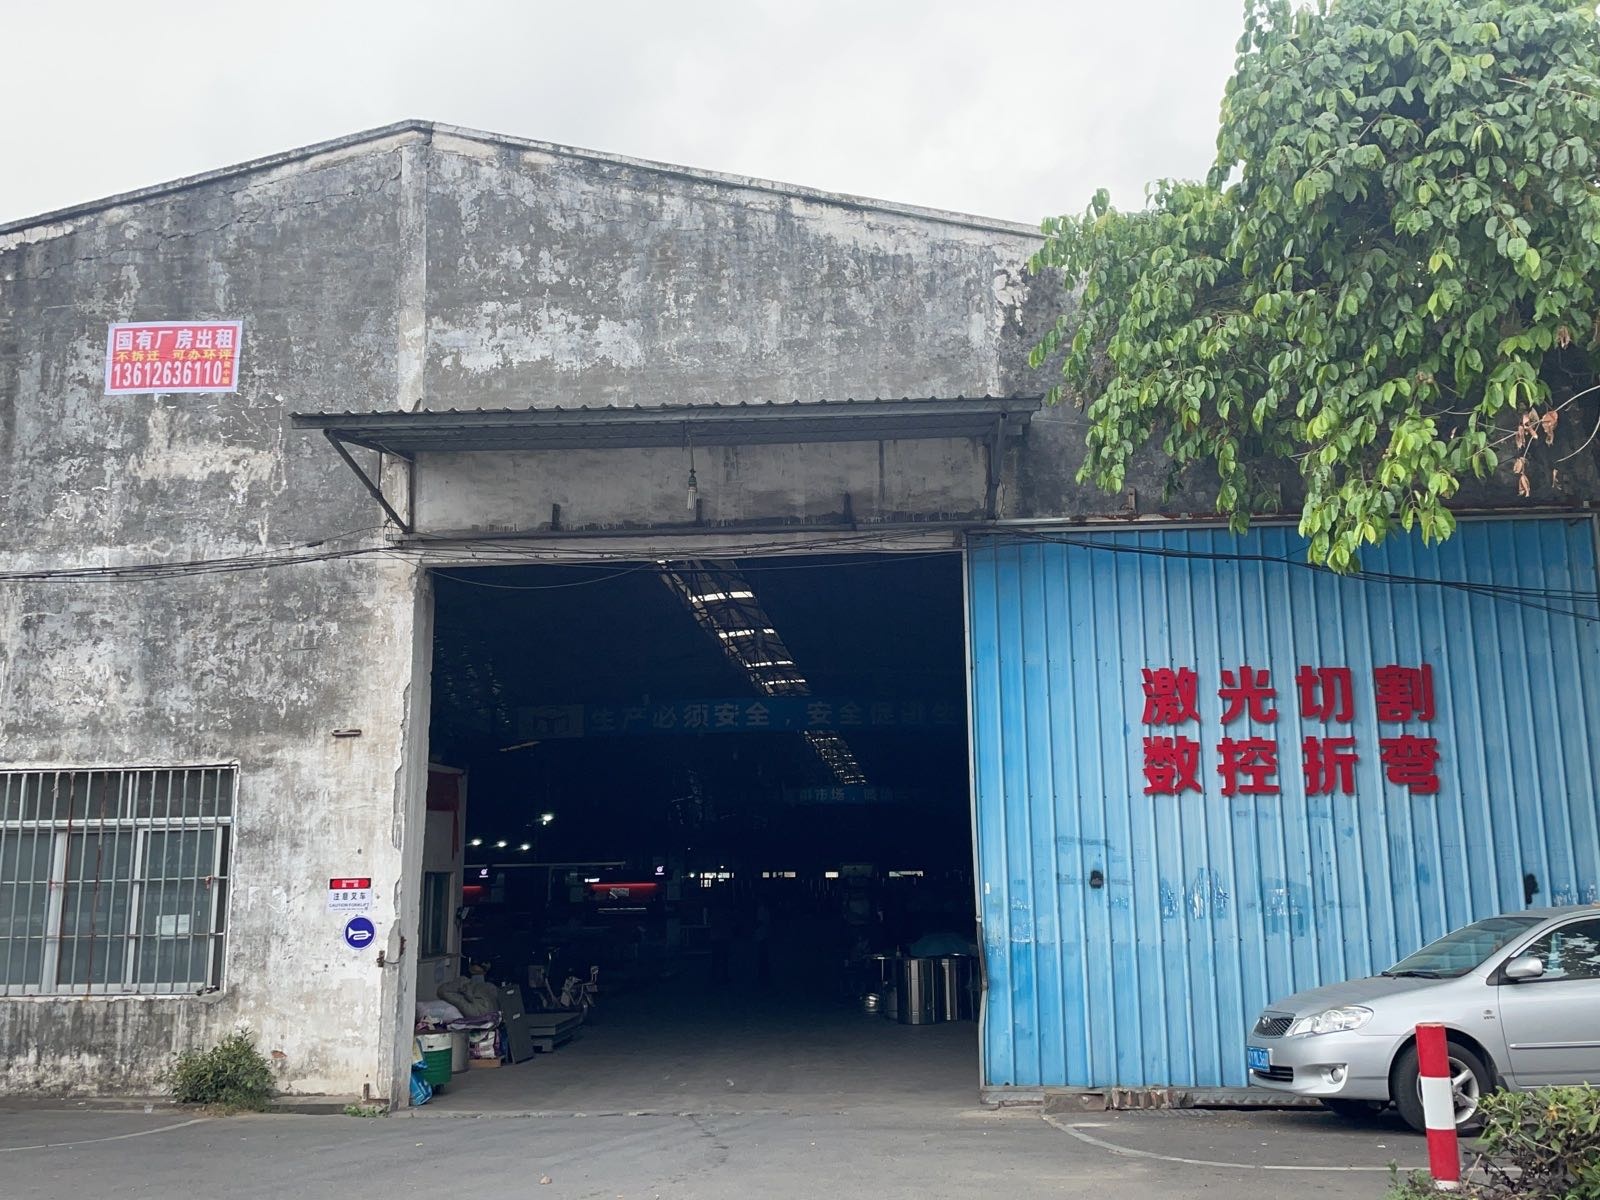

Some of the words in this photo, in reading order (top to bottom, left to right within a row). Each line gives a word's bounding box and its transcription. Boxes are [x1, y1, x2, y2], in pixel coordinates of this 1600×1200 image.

[115, 328, 233, 351] 国有厂房出租
[114, 360, 223, 386] 13612636110
[1141, 664, 1436, 725] 激光切割
[1142, 734, 1440, 796] 数控折弯
